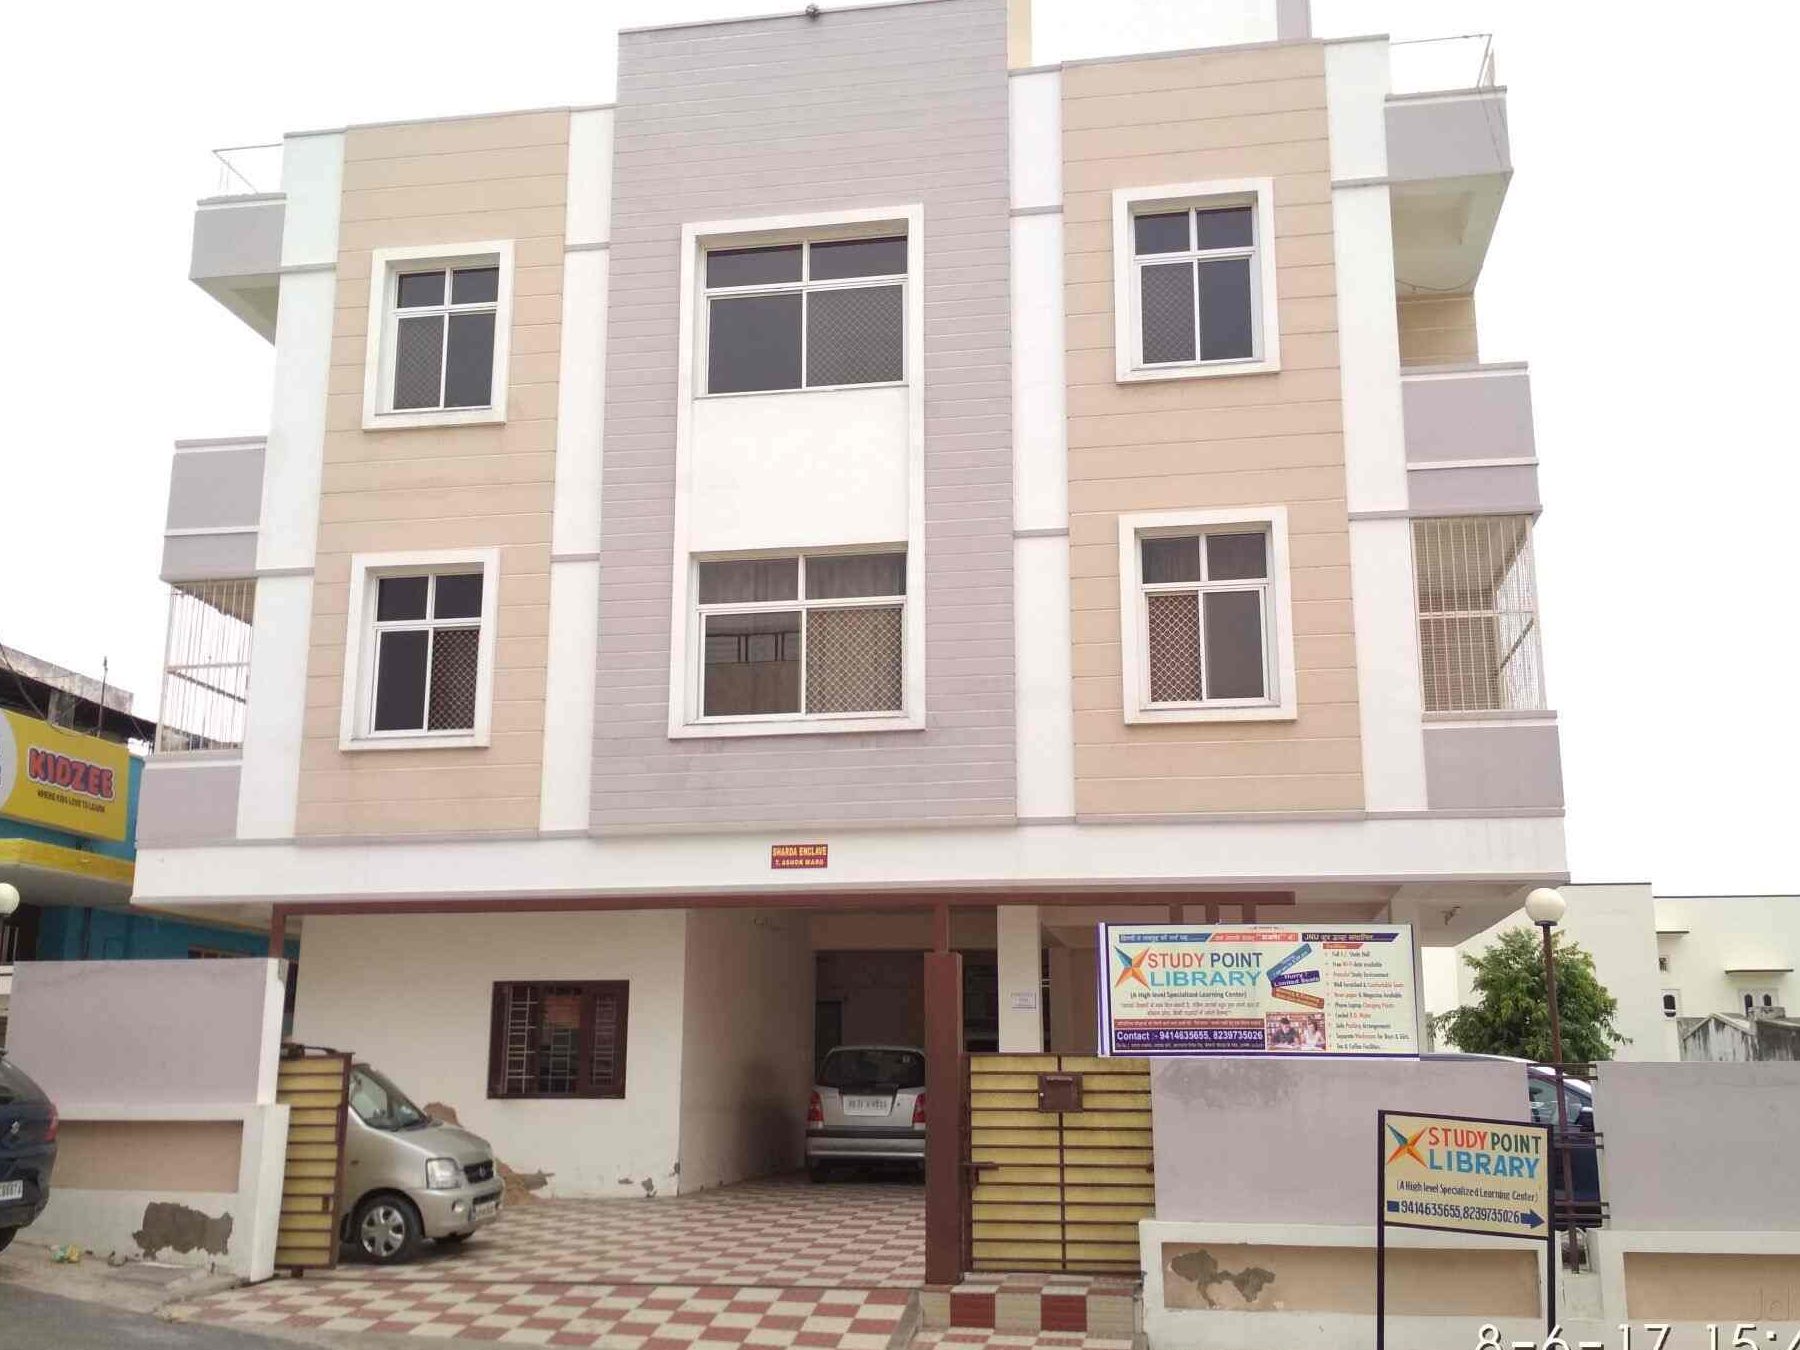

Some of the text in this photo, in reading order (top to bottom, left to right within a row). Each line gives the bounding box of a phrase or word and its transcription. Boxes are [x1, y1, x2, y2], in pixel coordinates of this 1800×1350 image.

[29, 748, 113, 799] KIDZEE
[1148, 952, 1205, 968] STUDY
[1211, 952, 1263, 968] POINT
[1150, 971, 1262, 987] LIBRARY
[1274, 979, 1301, 987] Limited
[1199, 991, 1224, 999] Learning
[1225, 991, 1247, 999] Center)
[1117, 1031, 1150, 1040] Contact
[1213, 1031, 1263, 1040] 8239735026
[1428, 1127, 1542, 1155] STUDY POINT
[1429, 1149, 1540, 1179] LIBRARY
[1405, 1182, 1422, 1192] High
[1423, 1183, 1439, 1193] level
[1439, 1184, 1479, 1197] Specialized
[1479, 1187, 1510, 1201] Learning
[1511, 1189, 1538, 1203] Center)
